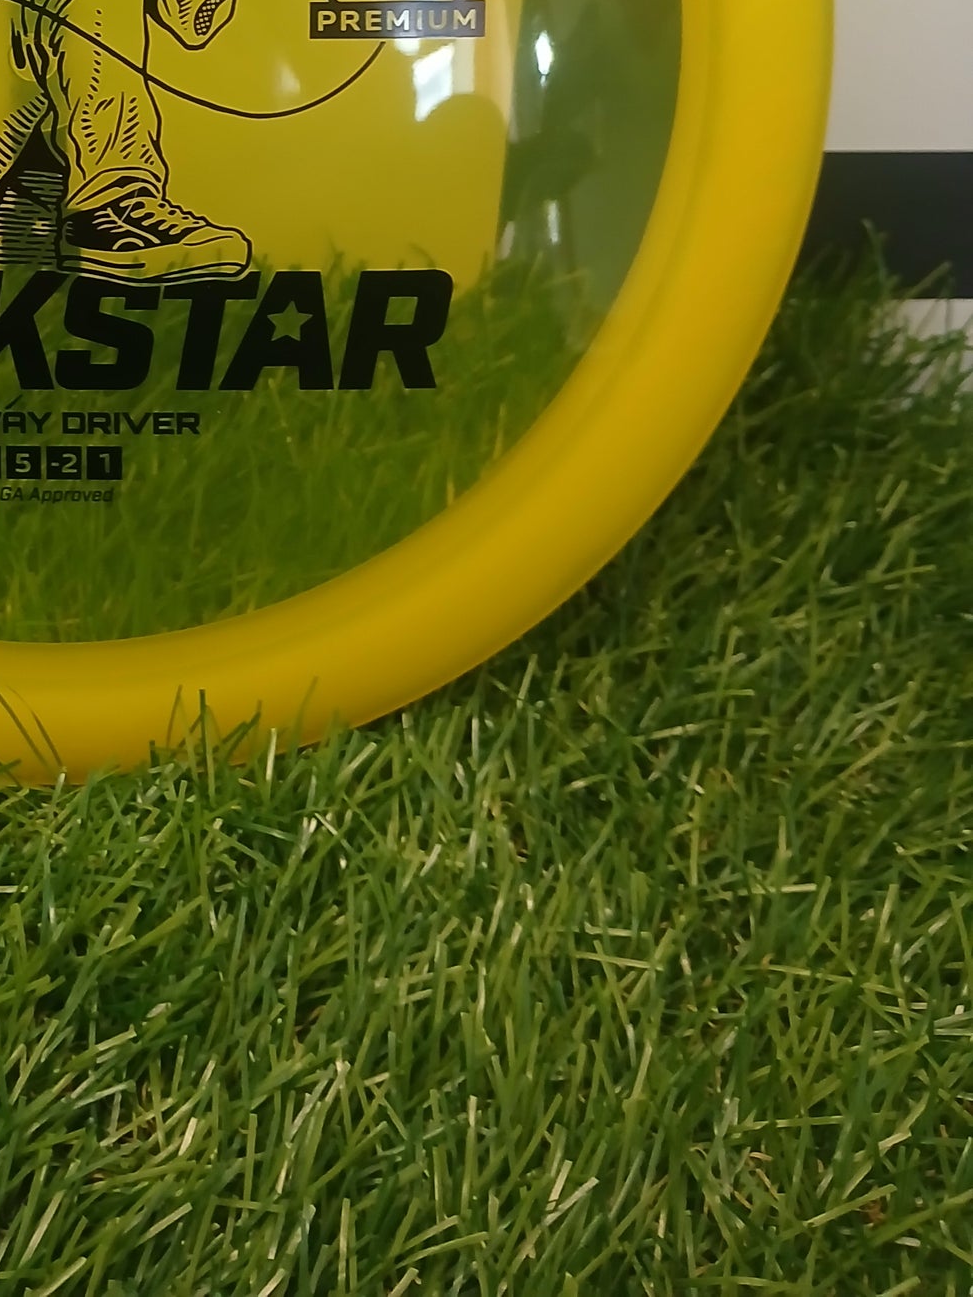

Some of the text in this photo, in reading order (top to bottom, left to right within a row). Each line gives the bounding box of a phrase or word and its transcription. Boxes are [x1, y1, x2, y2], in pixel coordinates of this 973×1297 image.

[317, 9, 476, 31] PREMIUM
[62, 411, 201, 435] DRIVER
[14, 453, 32, 473] 5
[27, 486, 115, 505] Approved
